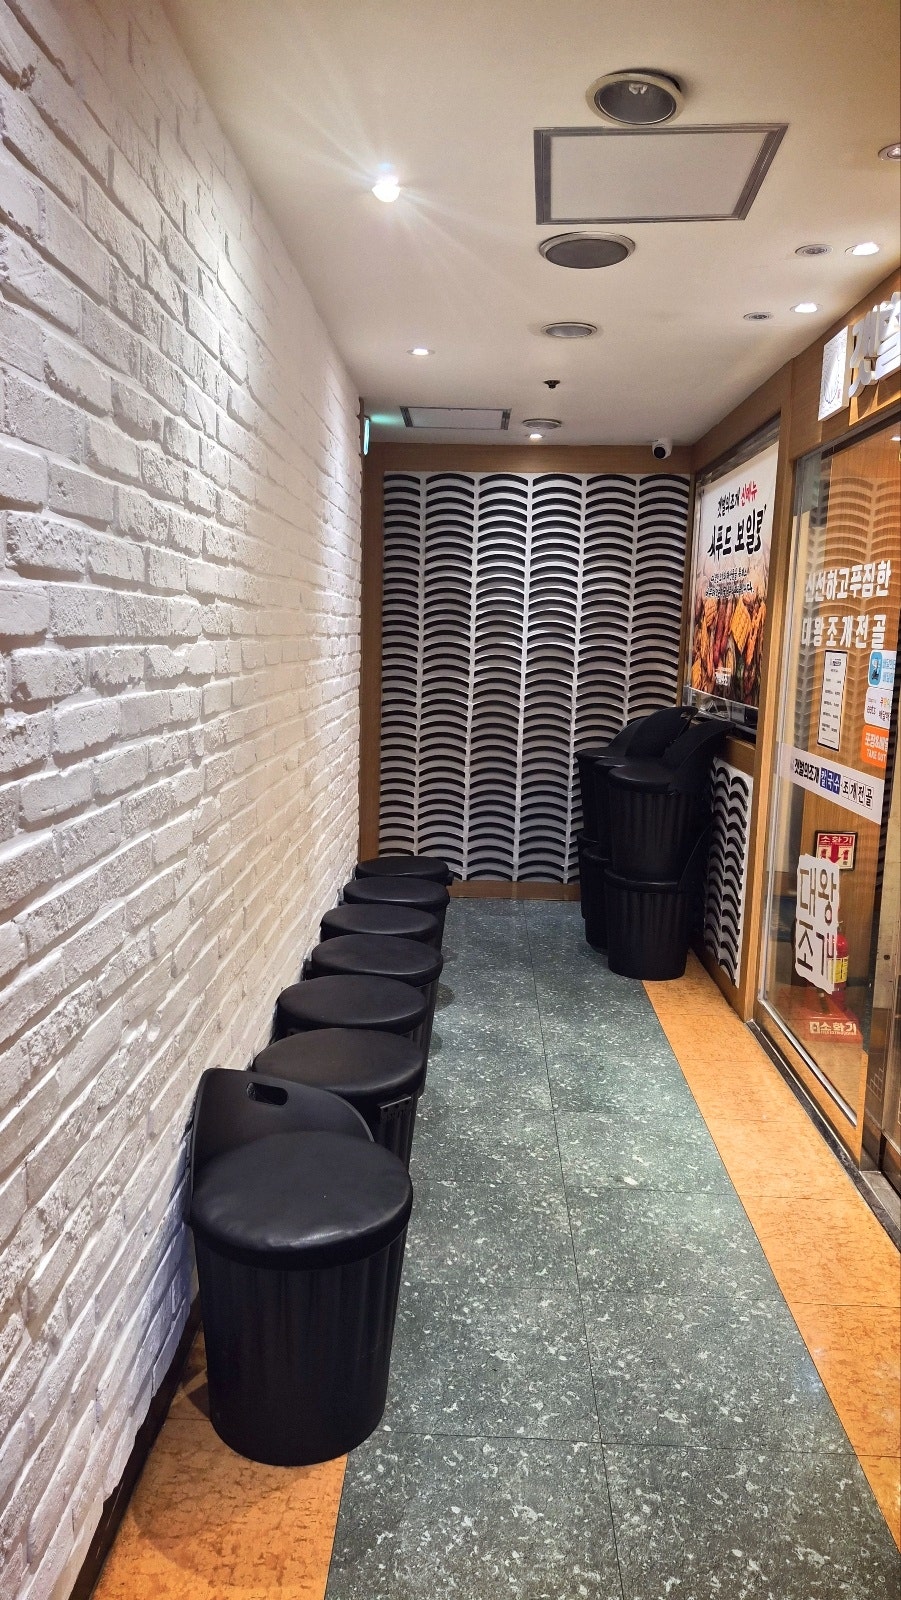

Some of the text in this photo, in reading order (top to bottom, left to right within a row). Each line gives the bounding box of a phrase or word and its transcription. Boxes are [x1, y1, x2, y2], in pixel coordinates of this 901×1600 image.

[741, 481, 758, 506] 신메뉴
[820, 768, 841, 794] 칼국수
[820, 835, 853, 844] 소화기
[800, 867, 837, 926] 대왕
[797, 919, 836, 985] 조개
[820, 1021, 857, 1035] 소화기
